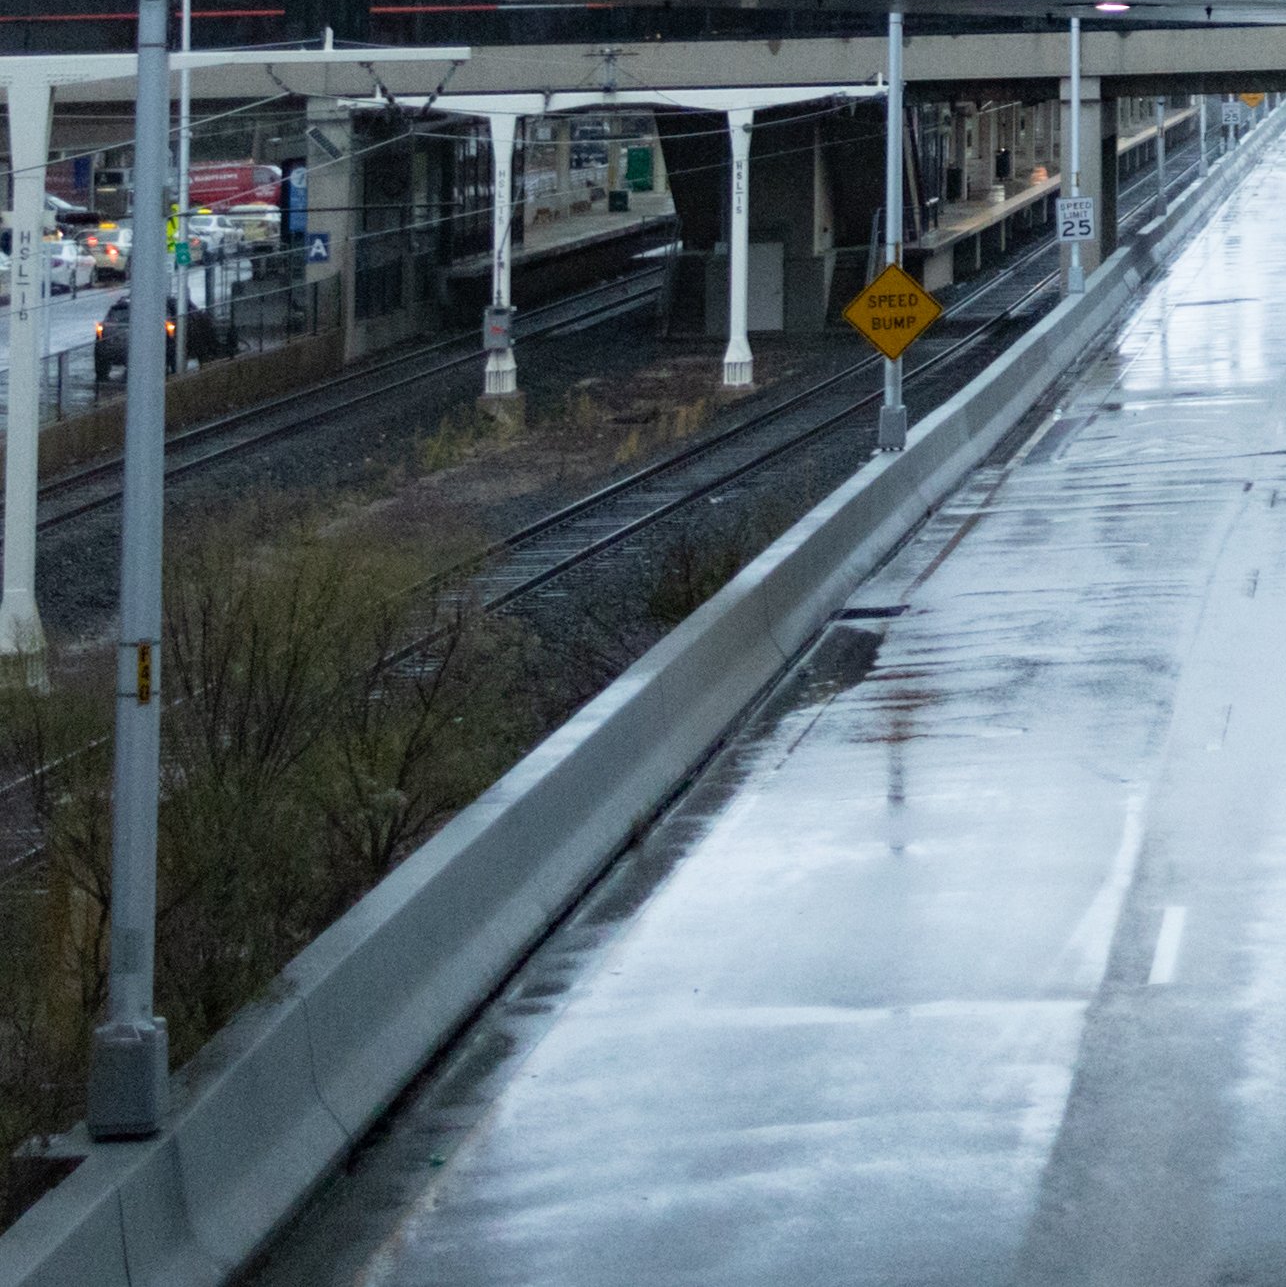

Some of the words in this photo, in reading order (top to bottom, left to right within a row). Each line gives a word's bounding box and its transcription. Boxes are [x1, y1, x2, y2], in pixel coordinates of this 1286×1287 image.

[1224, 114, 1239, 122] 25
[1060, 201, 1092, 211] SPEED
[1063, 211, 1088, 220] LIMIT
[1062, 219, 1092, 237] 25
[310, 238, 328, 258] A
[867, 293, 919, 308] SPEED
[871, 316, 916, 331] BUMP
